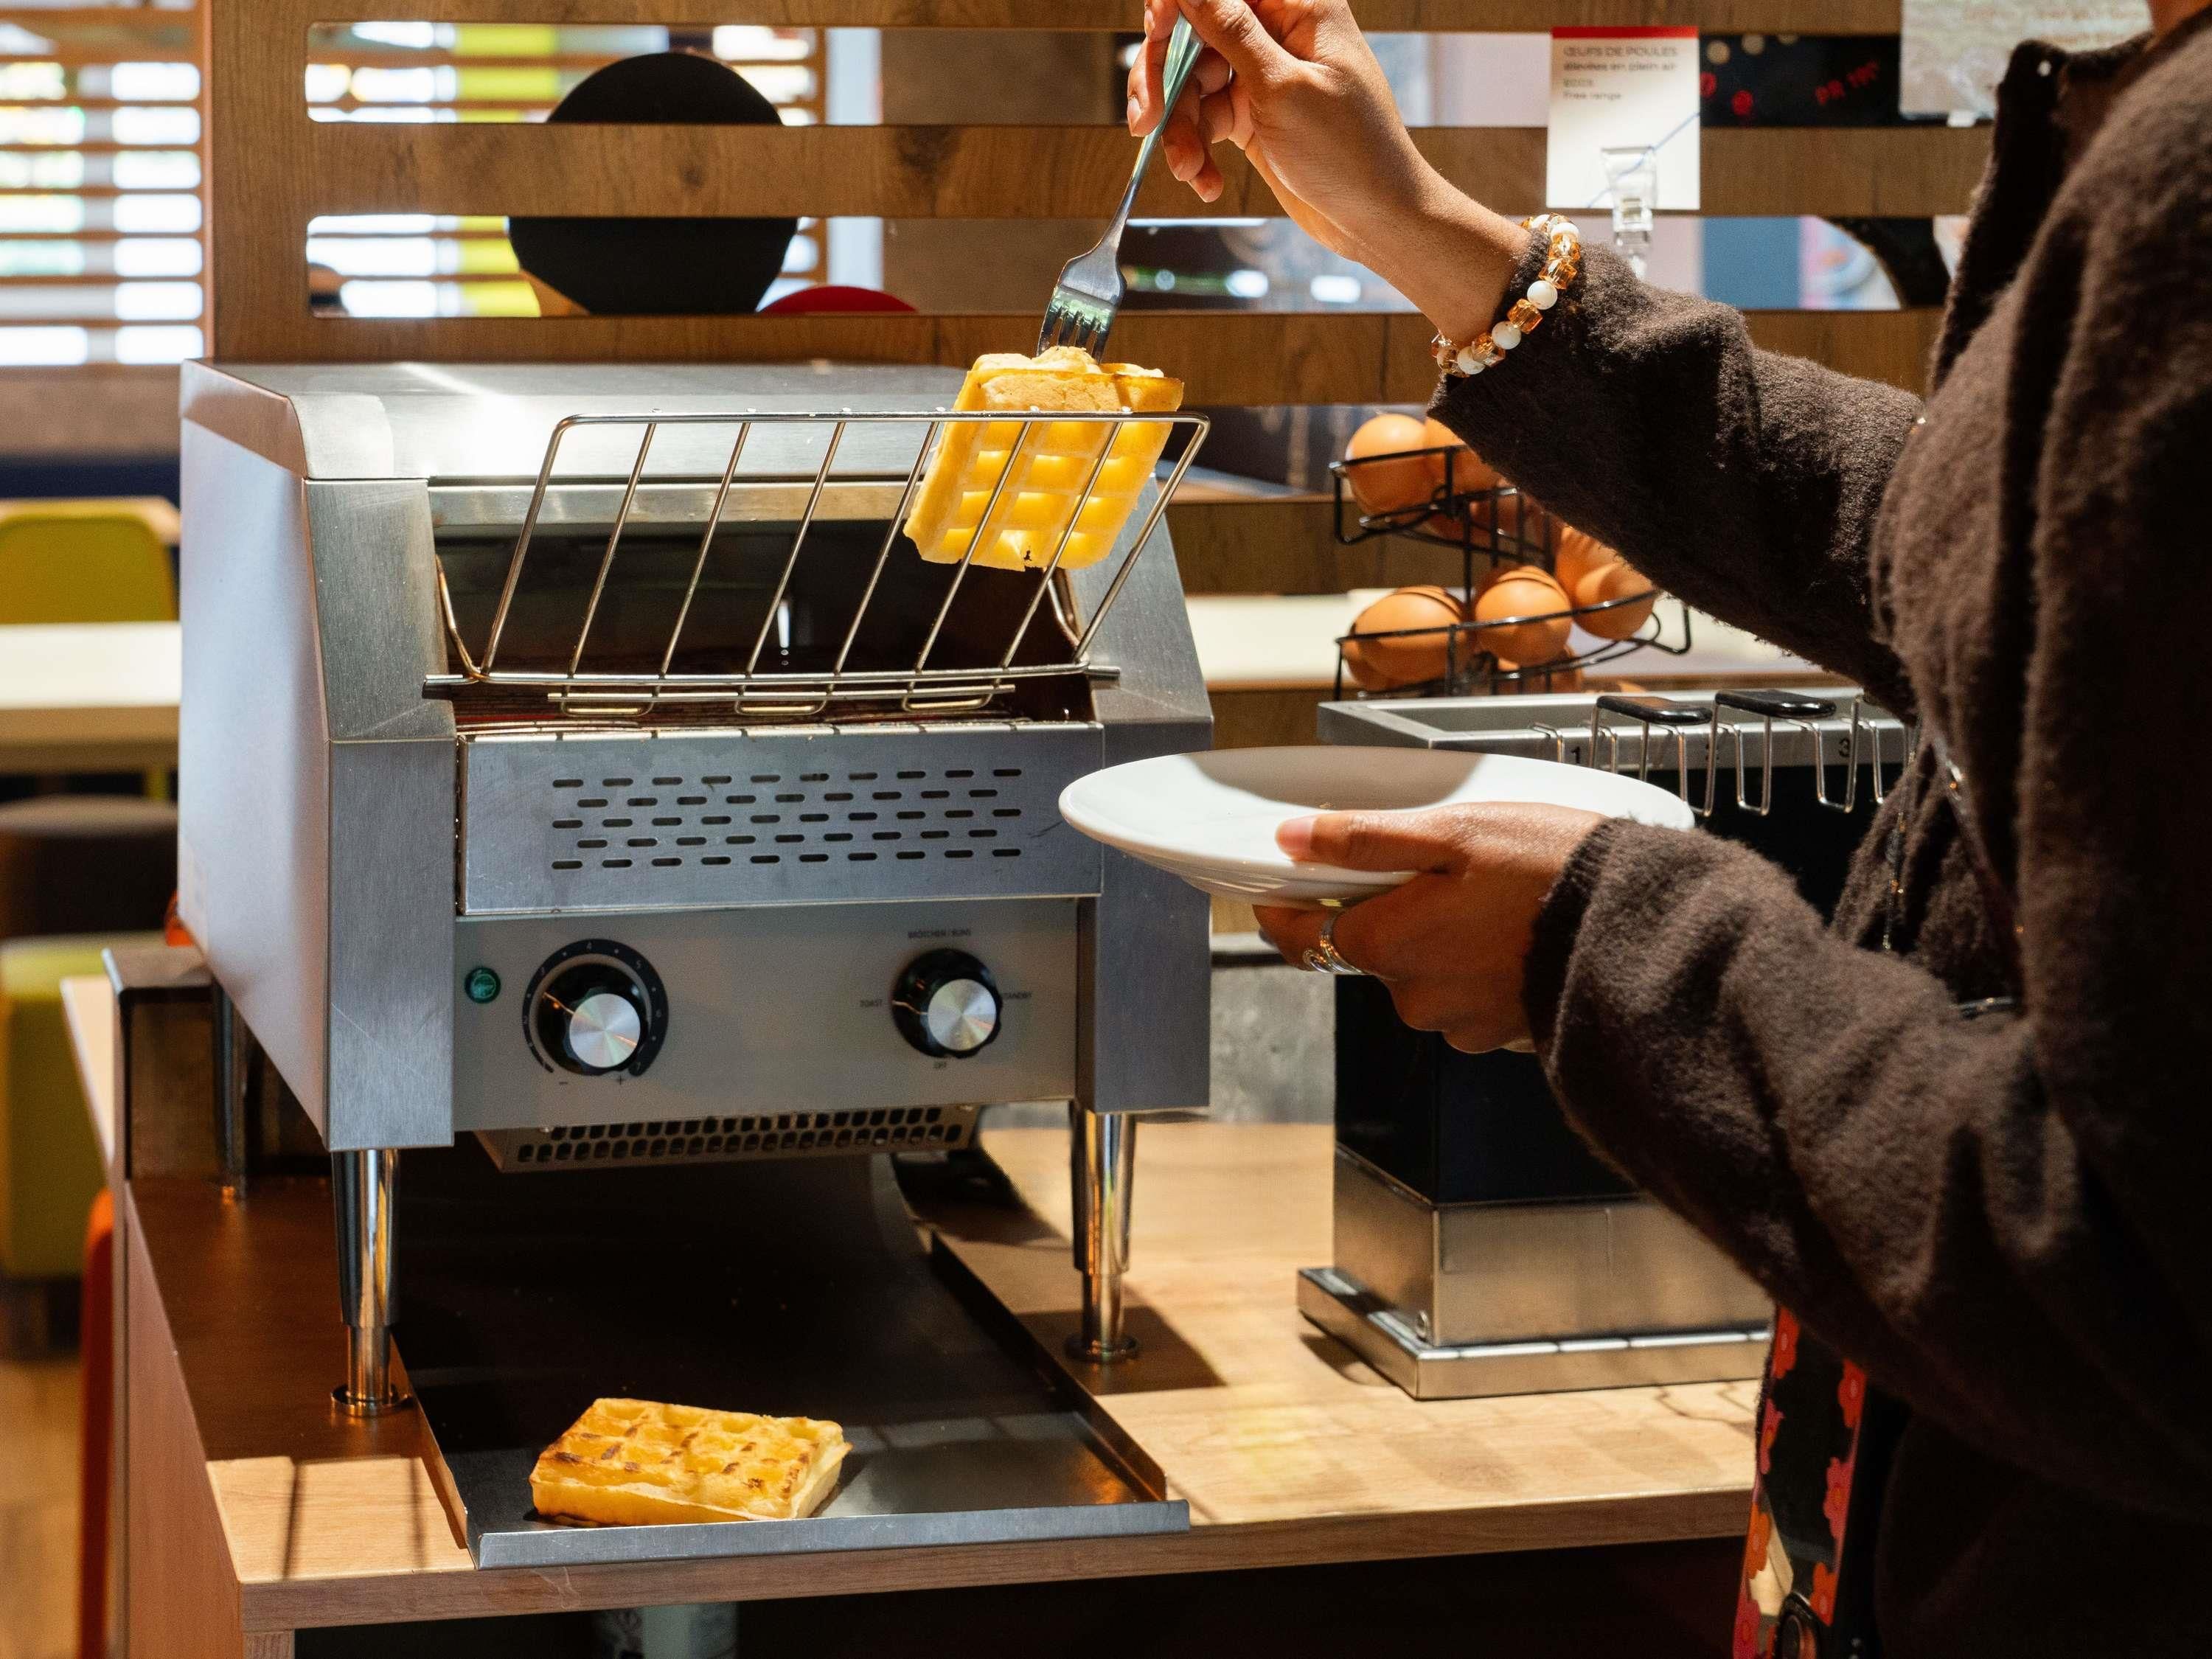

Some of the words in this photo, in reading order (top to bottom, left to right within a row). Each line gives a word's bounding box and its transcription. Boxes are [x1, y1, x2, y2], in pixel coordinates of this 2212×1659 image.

[1625, 46, 1677, 57] POULES
[1571, 746, 1580, 764] 1
[1838, 737, 1851, 758] 3
